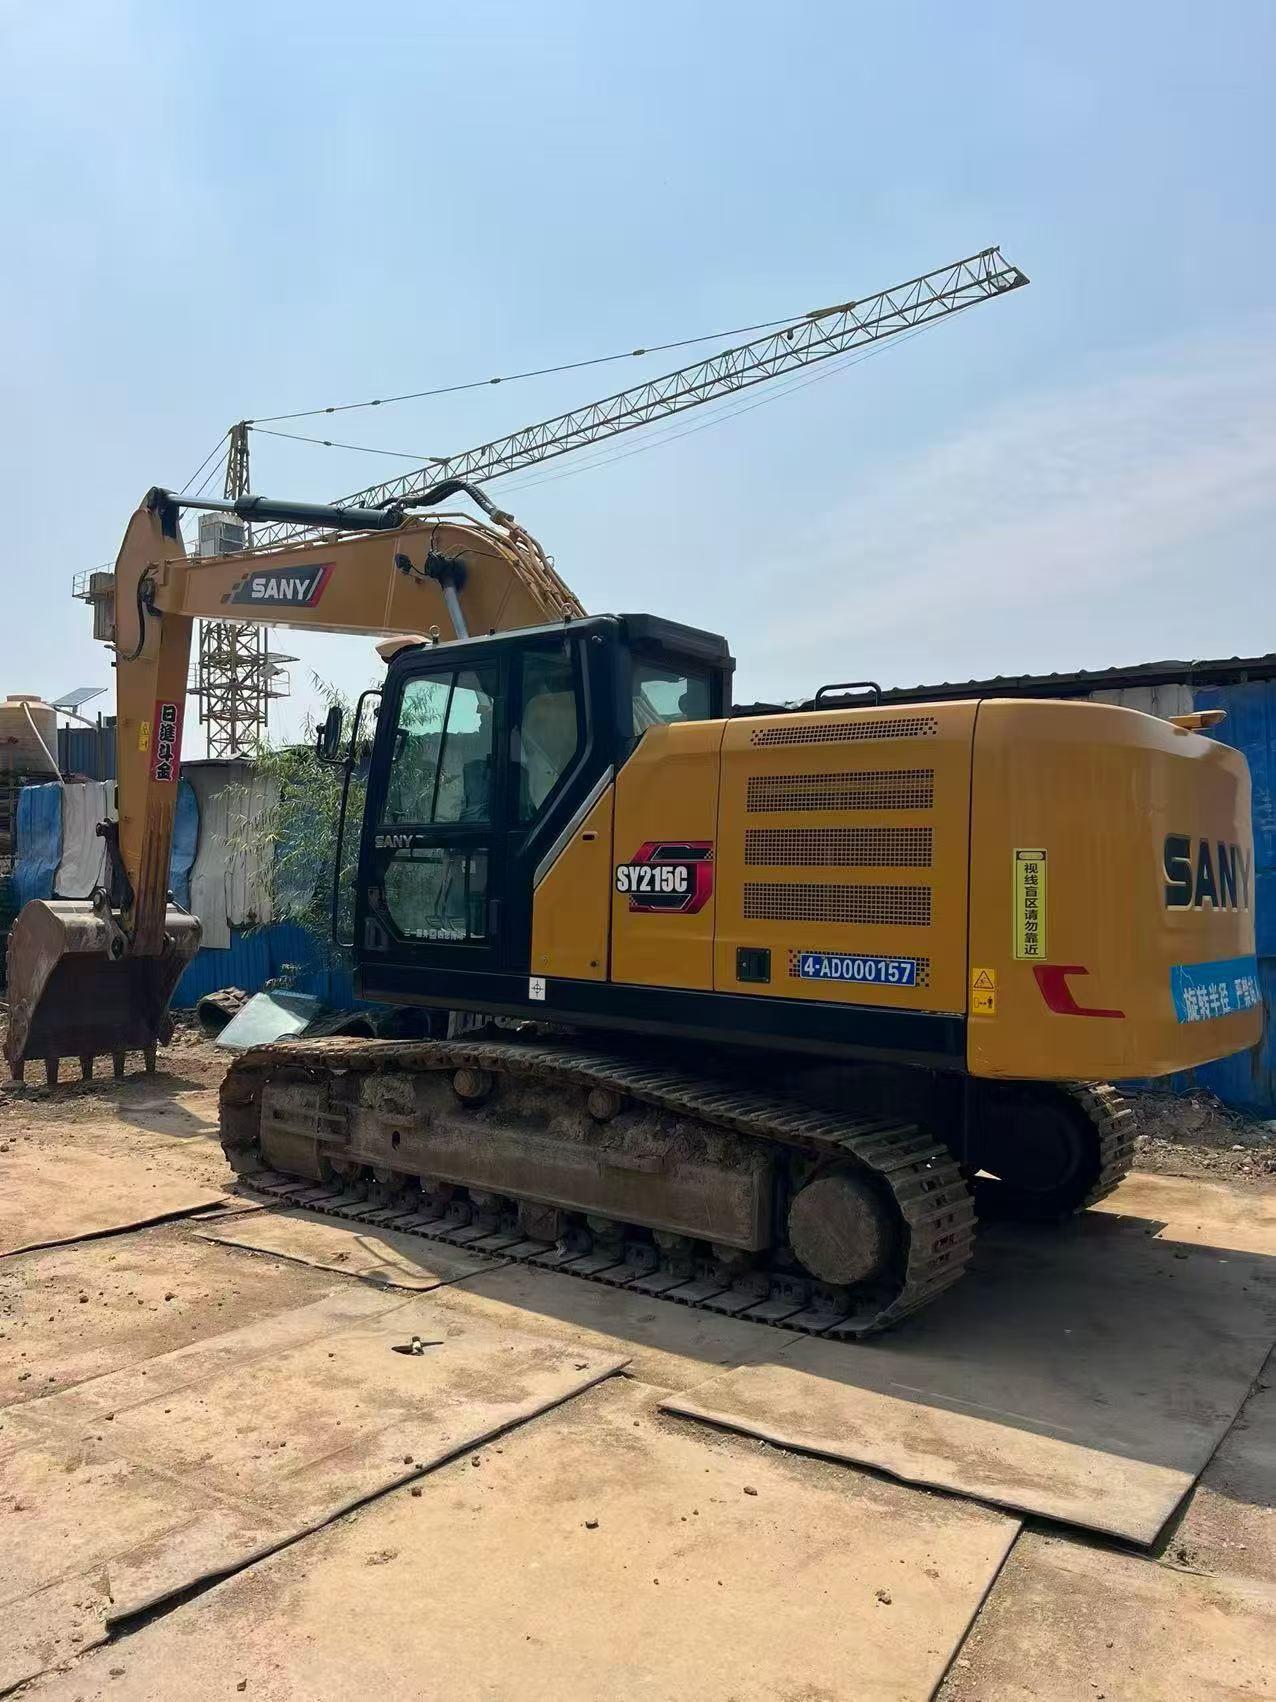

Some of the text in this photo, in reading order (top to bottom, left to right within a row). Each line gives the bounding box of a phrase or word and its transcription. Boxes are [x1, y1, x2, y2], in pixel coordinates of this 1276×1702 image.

[251, 578, 310, 600] SANY
[374, 835, 413, 848] SANY
[616, 865, 688, 892] SY215C
[1163, 833, 1251, 913] SANY
[1024, 862, 1039, 956] 视线盲区请勿靠近
[804, 957, 912, 983] 4-AD000157
[1183, 981, 1231, 1022] 旋转半径
